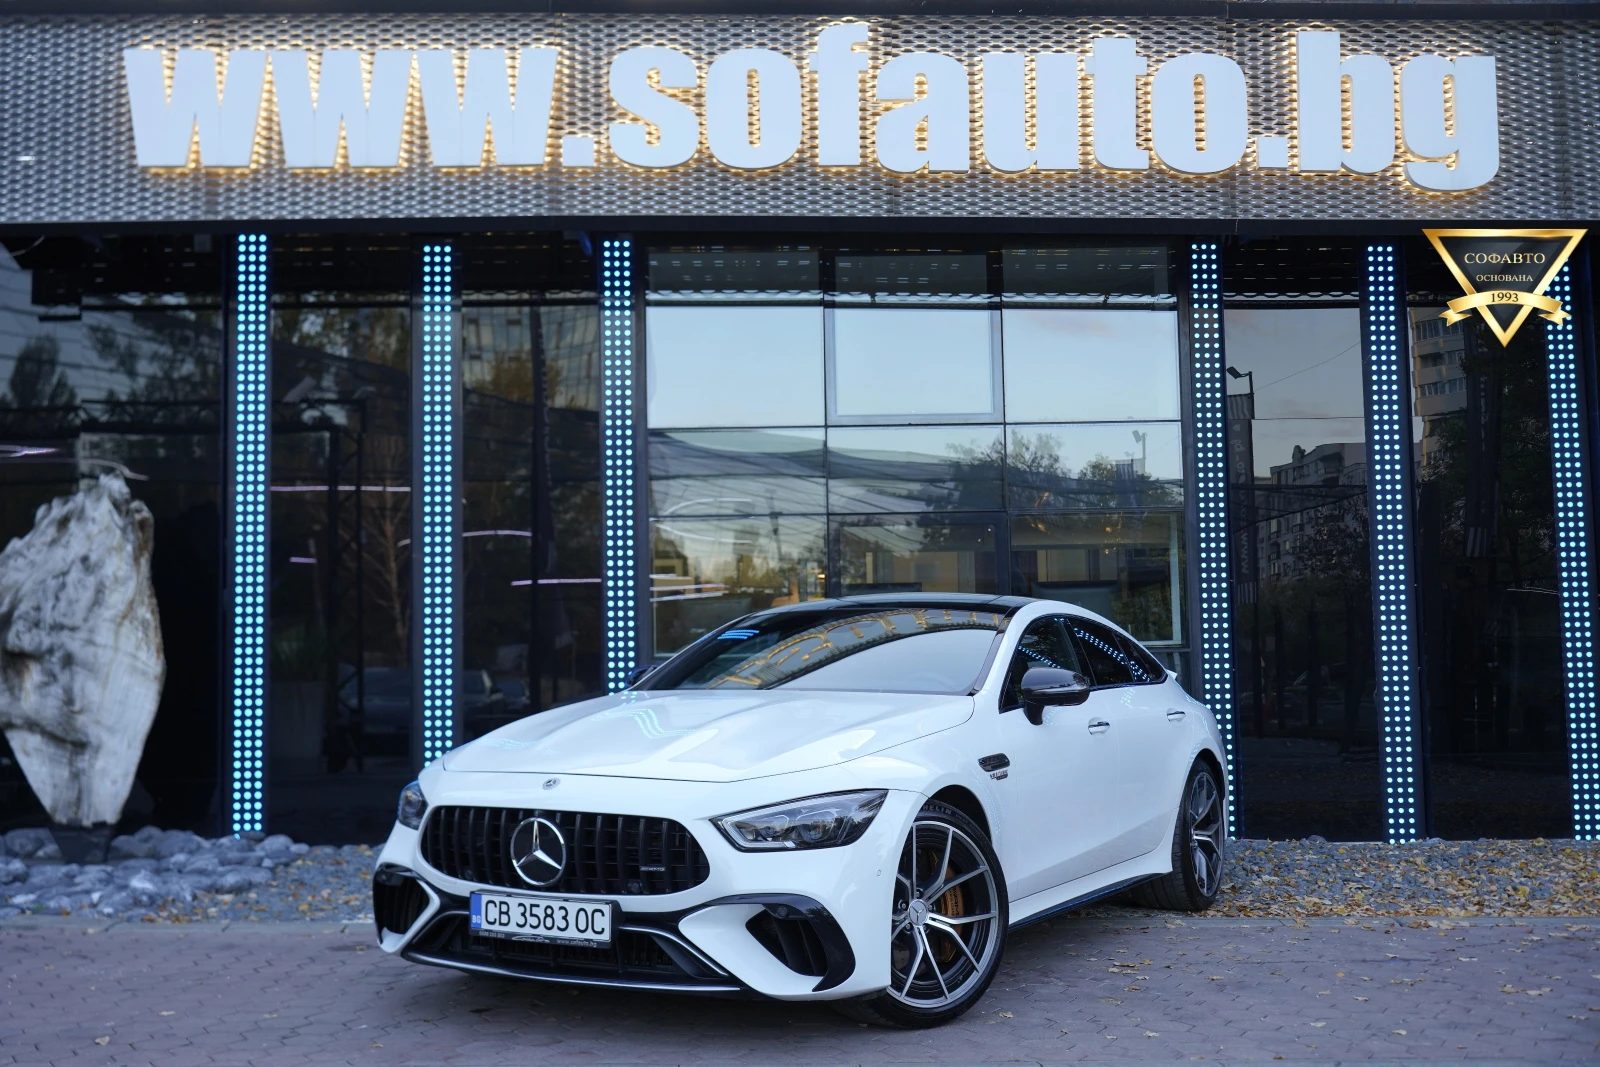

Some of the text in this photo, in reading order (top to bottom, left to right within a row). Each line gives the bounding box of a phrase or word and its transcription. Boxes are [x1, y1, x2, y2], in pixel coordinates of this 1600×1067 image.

[122, 21, 1500, 193] www.sofauto.bg
[922, 804, 952, 815] HELIN
[472, 915, 482, 923] BG
[485, 899, 606, 935] CB 3583 OC
